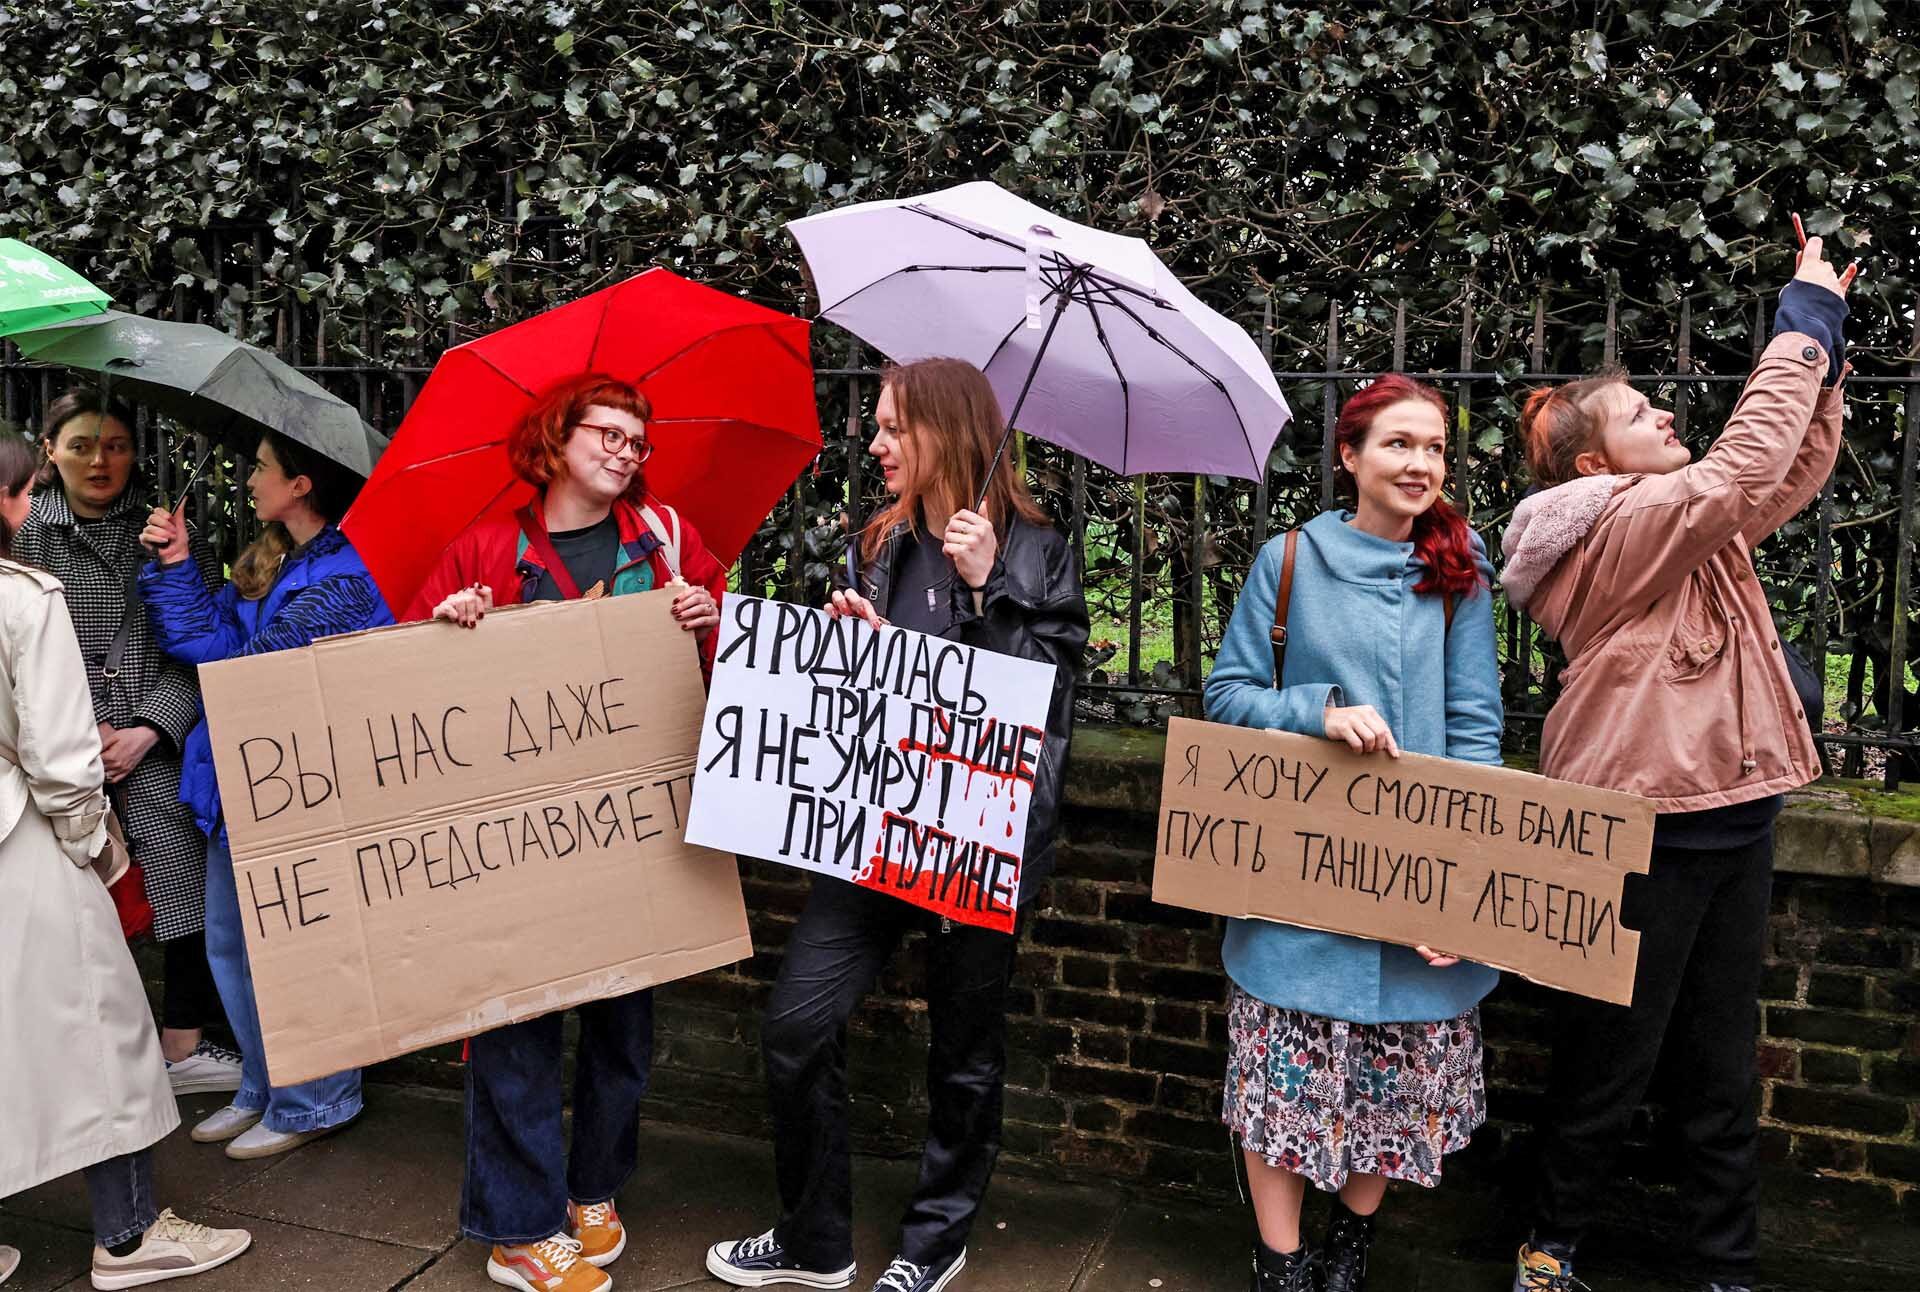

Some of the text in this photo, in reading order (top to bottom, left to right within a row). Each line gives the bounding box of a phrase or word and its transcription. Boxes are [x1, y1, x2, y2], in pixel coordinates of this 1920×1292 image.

[717, 598, 987, 716] Я РОДИЛАСЬ
[238, 678, 640, 823] ВЫ НАС ДАЖЕ
[704, 706, 954, 829] Я НЕ УМРУ!
[806, 686, 1043, 781] ПРИ ПУТИНЕ
[778, 792, 1021, 918] ПРИ ПУТИНЕ
[1177, 744, 1626, 861] Я ХОЧУ СМОТРЕТЬ БАЛЕТ
[245, 857, 331, 940] НЕ
[1165, 810, 1617, 959] ПУСТЬ ТАНЦУЮТ ЛЕБЕДИ
